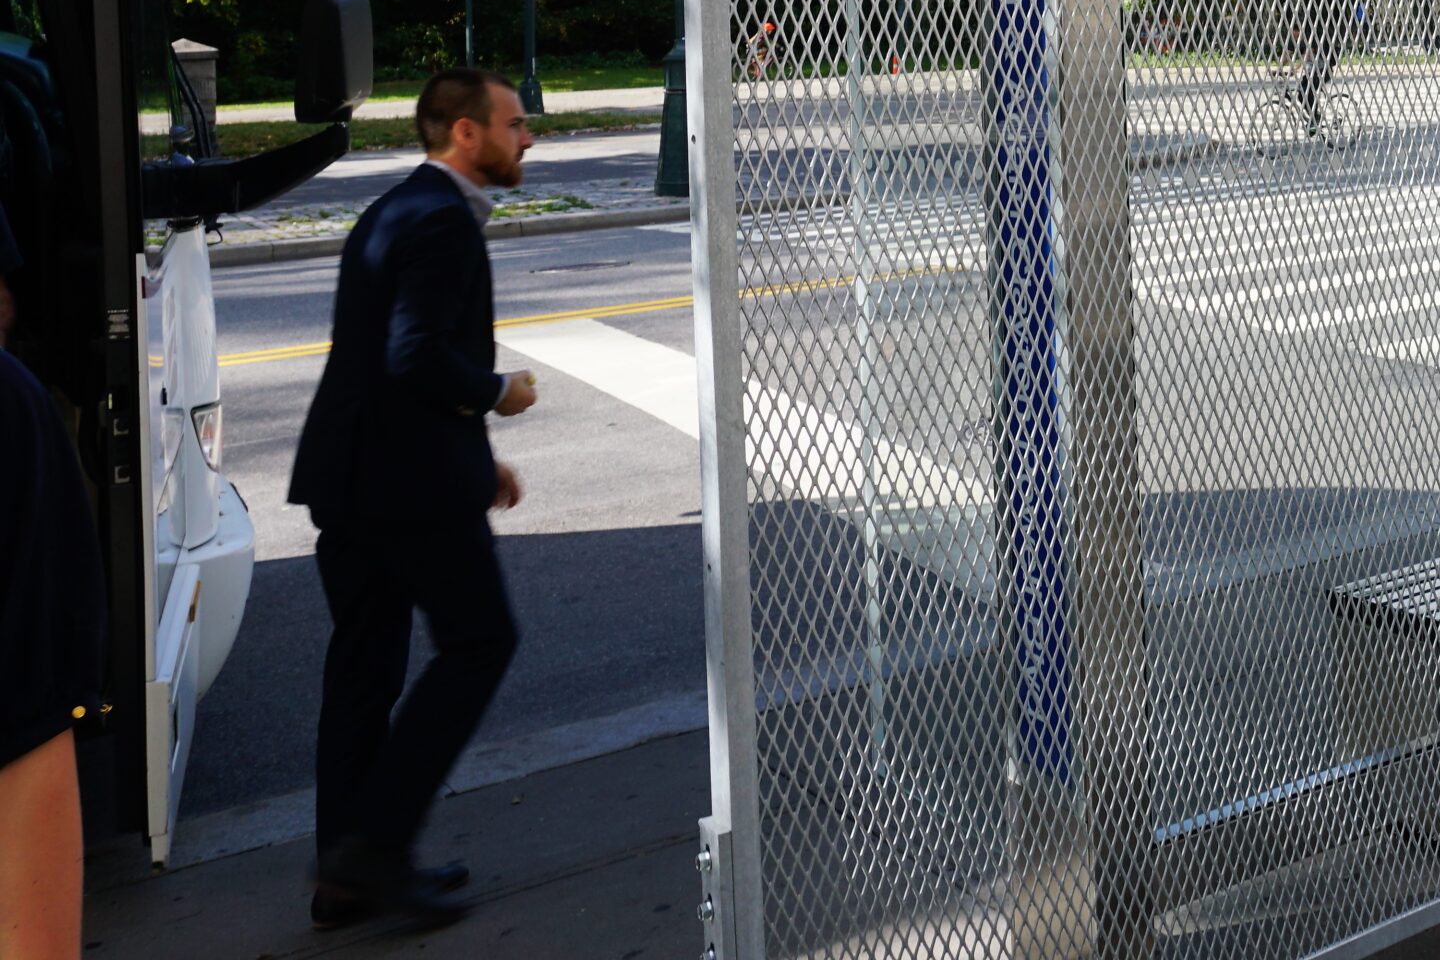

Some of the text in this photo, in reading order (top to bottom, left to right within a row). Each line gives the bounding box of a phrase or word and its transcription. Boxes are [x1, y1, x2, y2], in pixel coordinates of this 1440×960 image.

[1006, 79, 1028, 221] Adam
[1009, 237, 1034, 423] Clayton
[1016, 439, 1043, 599] Powell
[1024, 613, 1045, 723] Blvd
